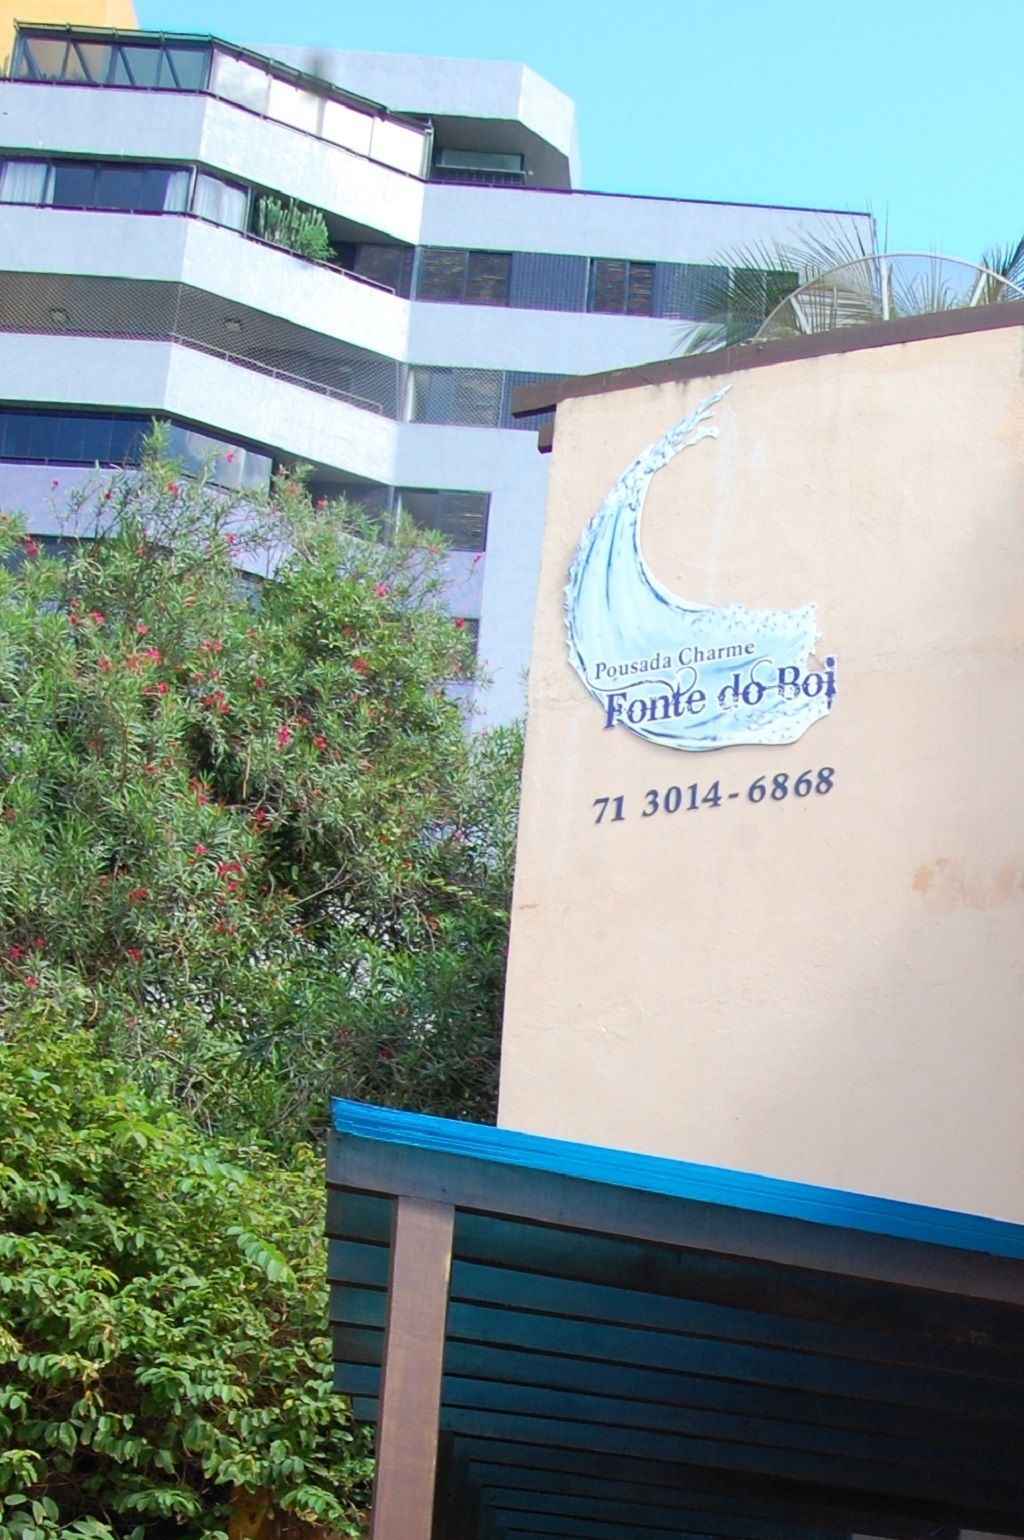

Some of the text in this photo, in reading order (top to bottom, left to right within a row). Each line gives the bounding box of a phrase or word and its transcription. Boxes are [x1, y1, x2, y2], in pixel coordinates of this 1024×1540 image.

[594, 642, 755, 680] Pousada Charme
[603, 656, 837, 730] Fonte do Boi
[592, 766, 836, 825] 71 3014-6868
